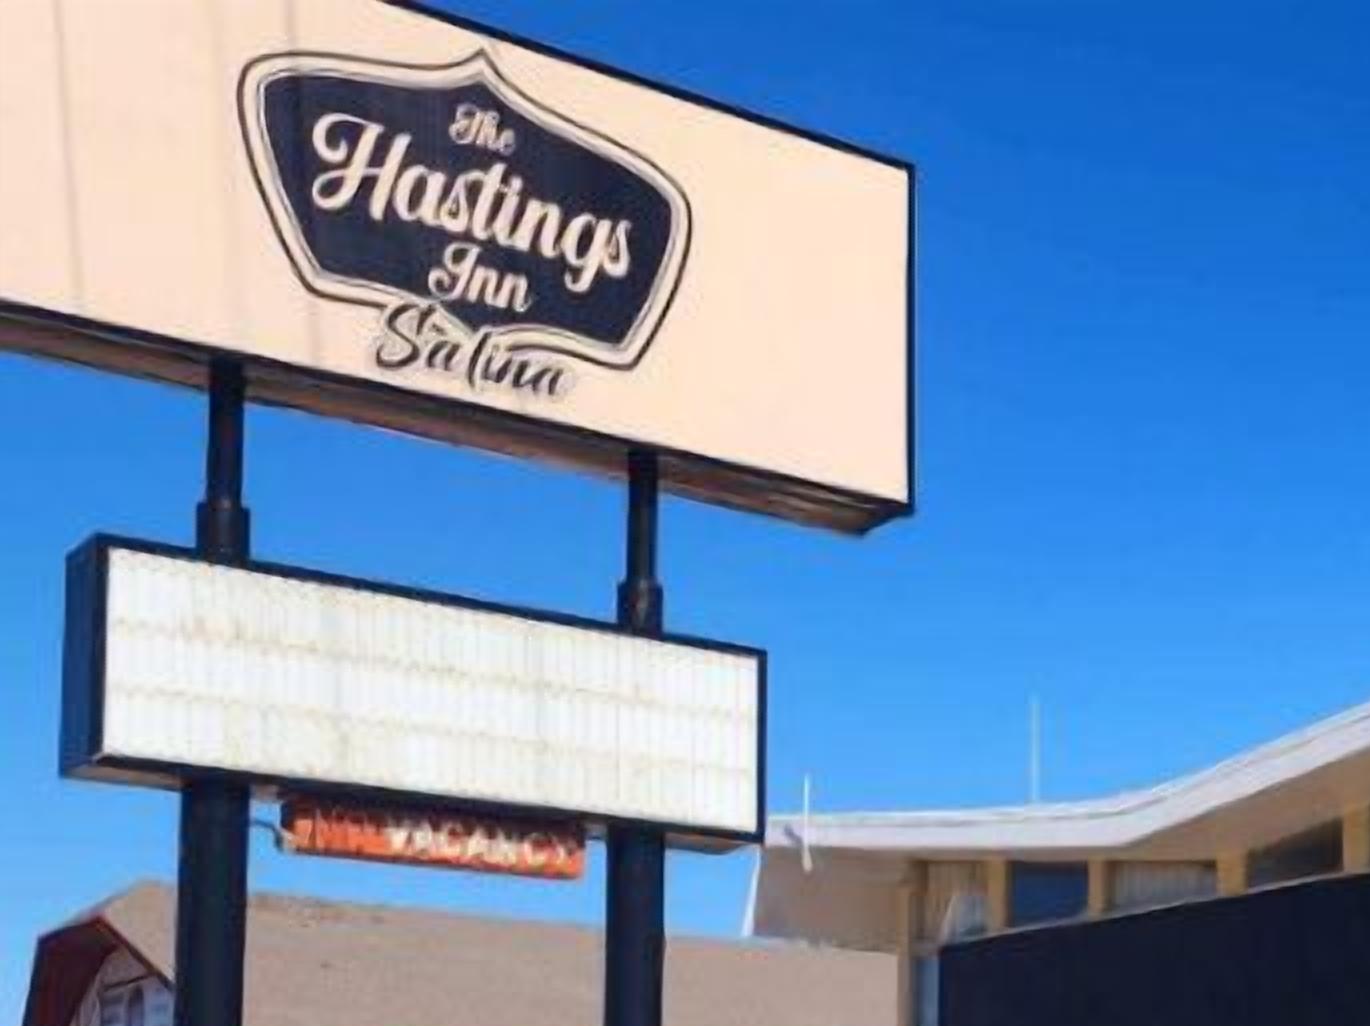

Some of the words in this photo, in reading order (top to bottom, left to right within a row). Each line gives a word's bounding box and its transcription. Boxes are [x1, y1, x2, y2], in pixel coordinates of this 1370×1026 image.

[448, 102, 517, 156] The
[311, 112, 632, 294] Hastings
[427, 241, 533, 314] Inn
[375, 301, 570, 398] Salina
